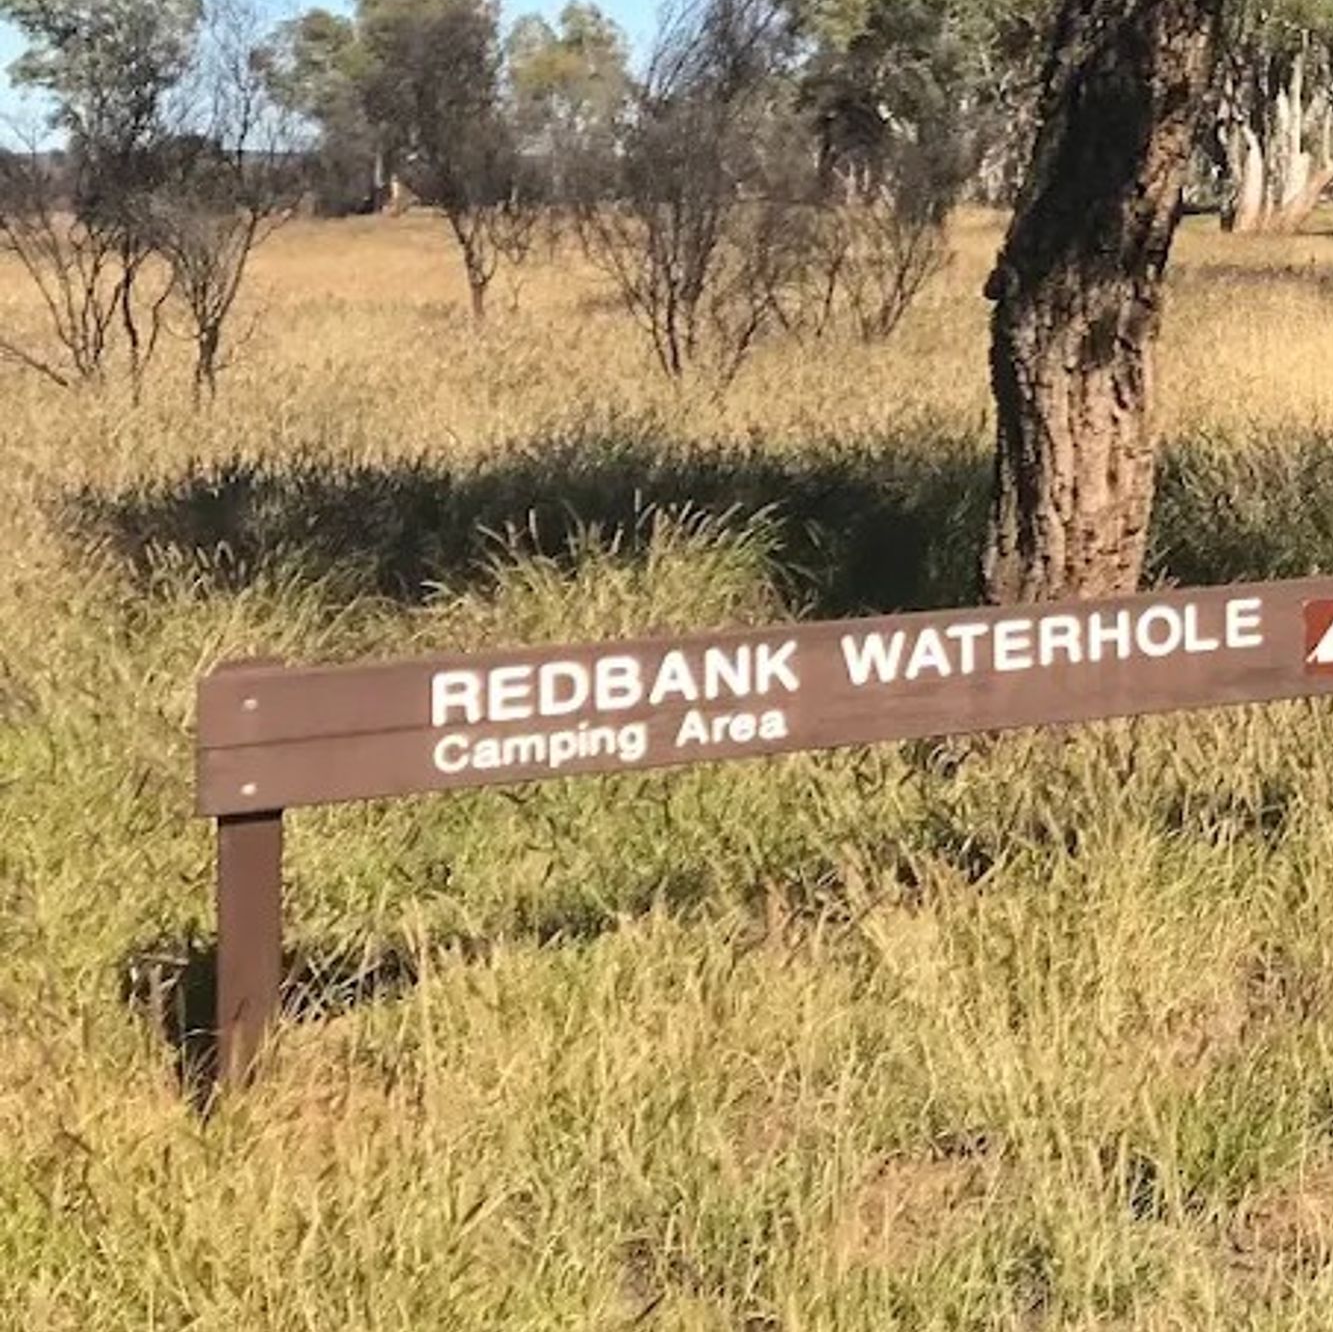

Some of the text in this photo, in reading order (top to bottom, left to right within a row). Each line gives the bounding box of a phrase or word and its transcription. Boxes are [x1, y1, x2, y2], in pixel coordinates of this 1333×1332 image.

[432, 597, 1264, 727] REDBANK WATERHOLE
[433, 709, 788, 773] Camping Area
